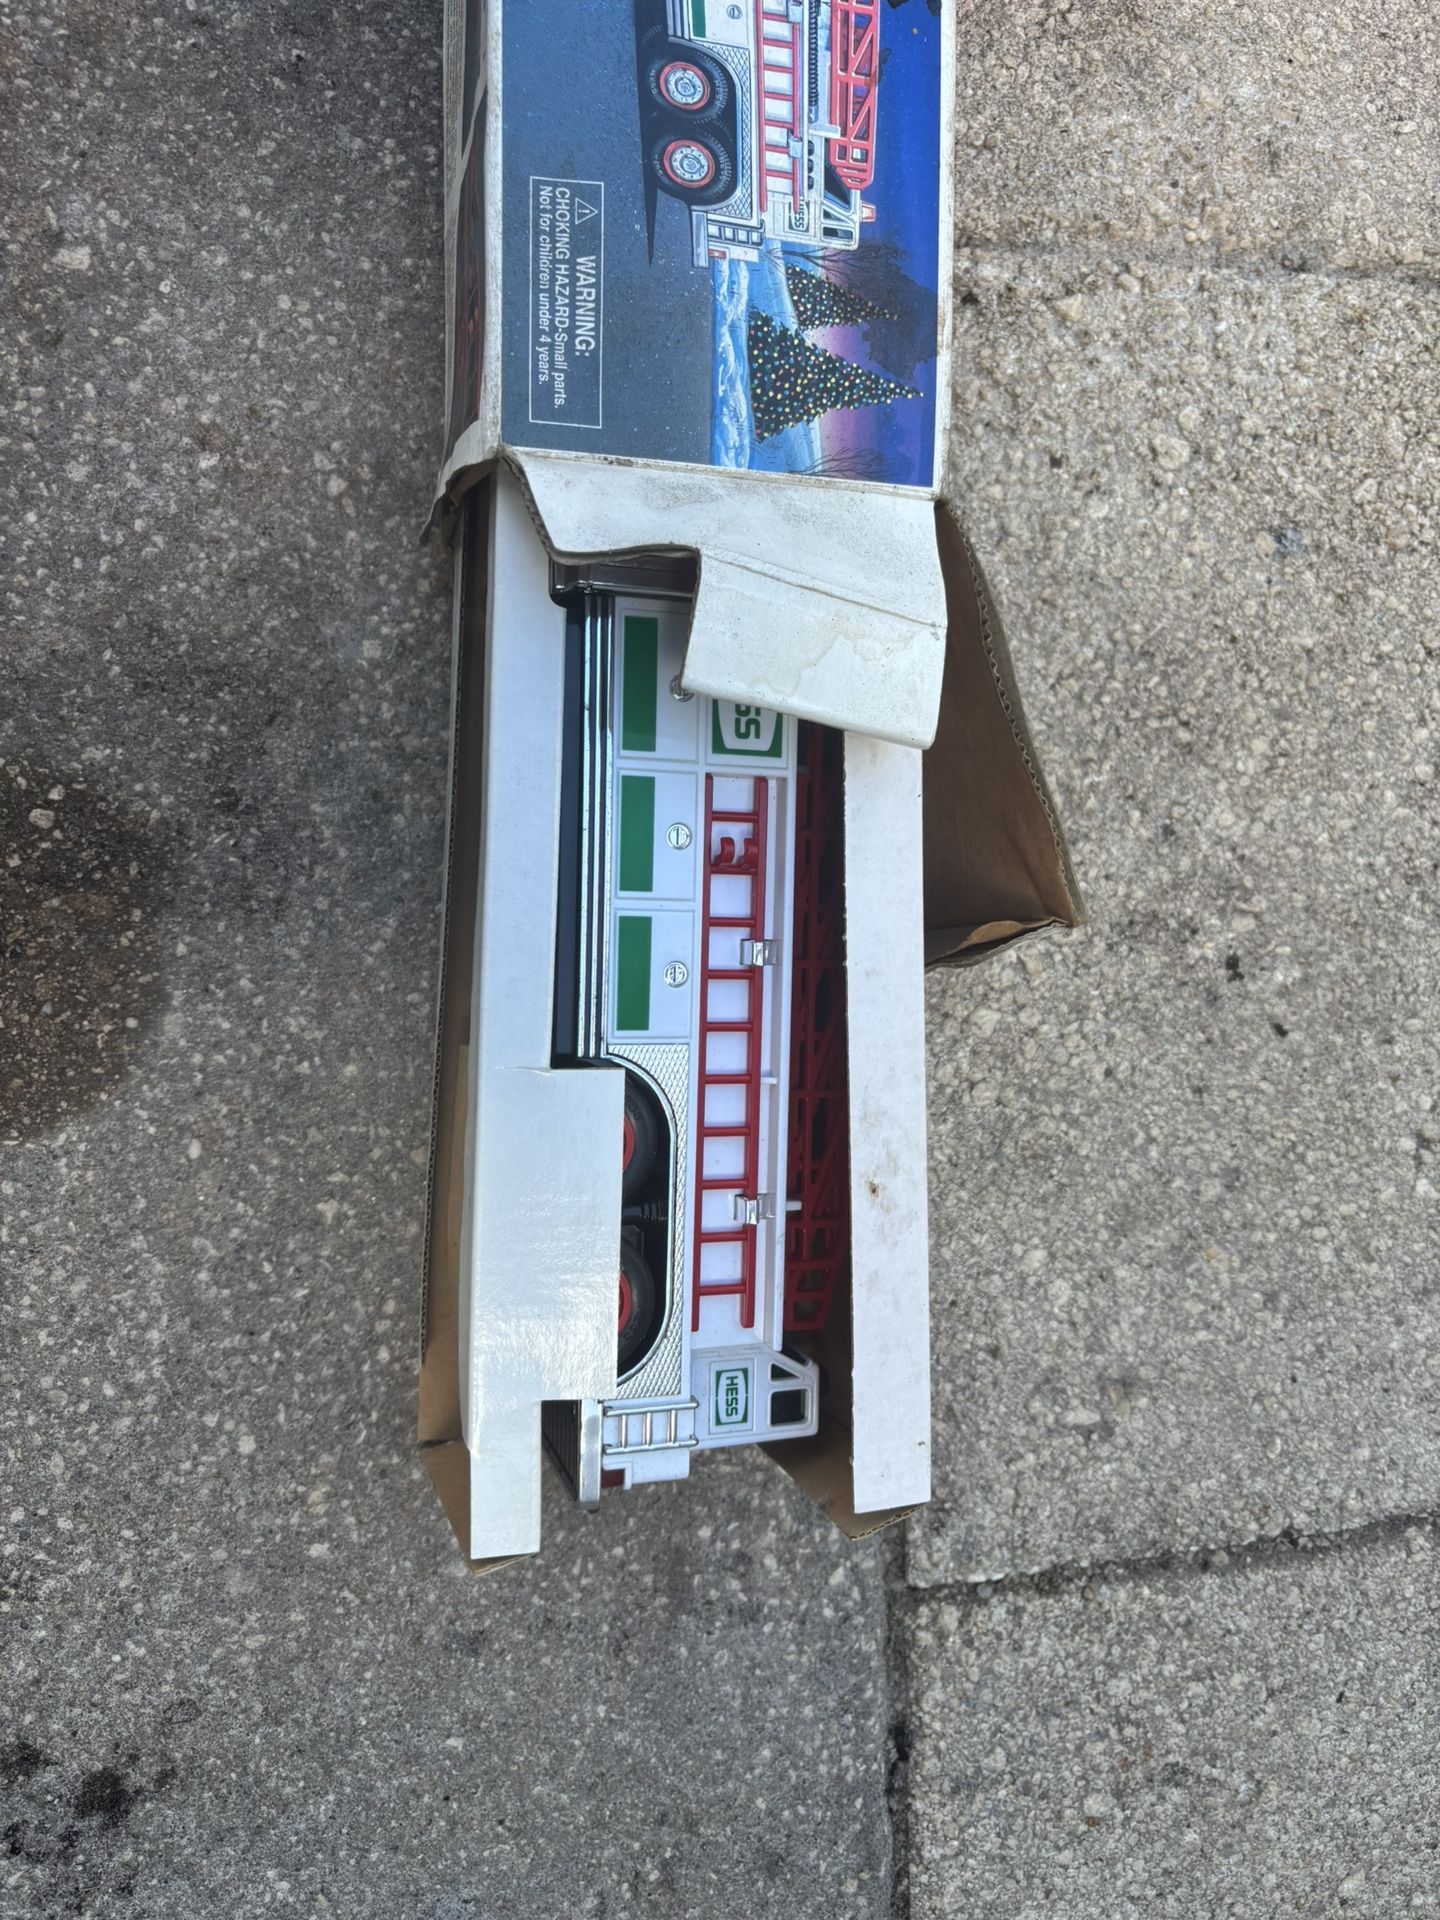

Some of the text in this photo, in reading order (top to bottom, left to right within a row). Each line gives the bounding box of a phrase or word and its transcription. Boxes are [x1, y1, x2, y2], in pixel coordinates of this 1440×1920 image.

[536, 185, 553, 385] Not for children under 4 years.
[553, 186, 570, 409] CHOKING HAZARD-Small parts.
[575, 255, 596, 356] WARNING:
[734, 704, 761, 739] SS
[725, 1375, 739, 1417] HESS
